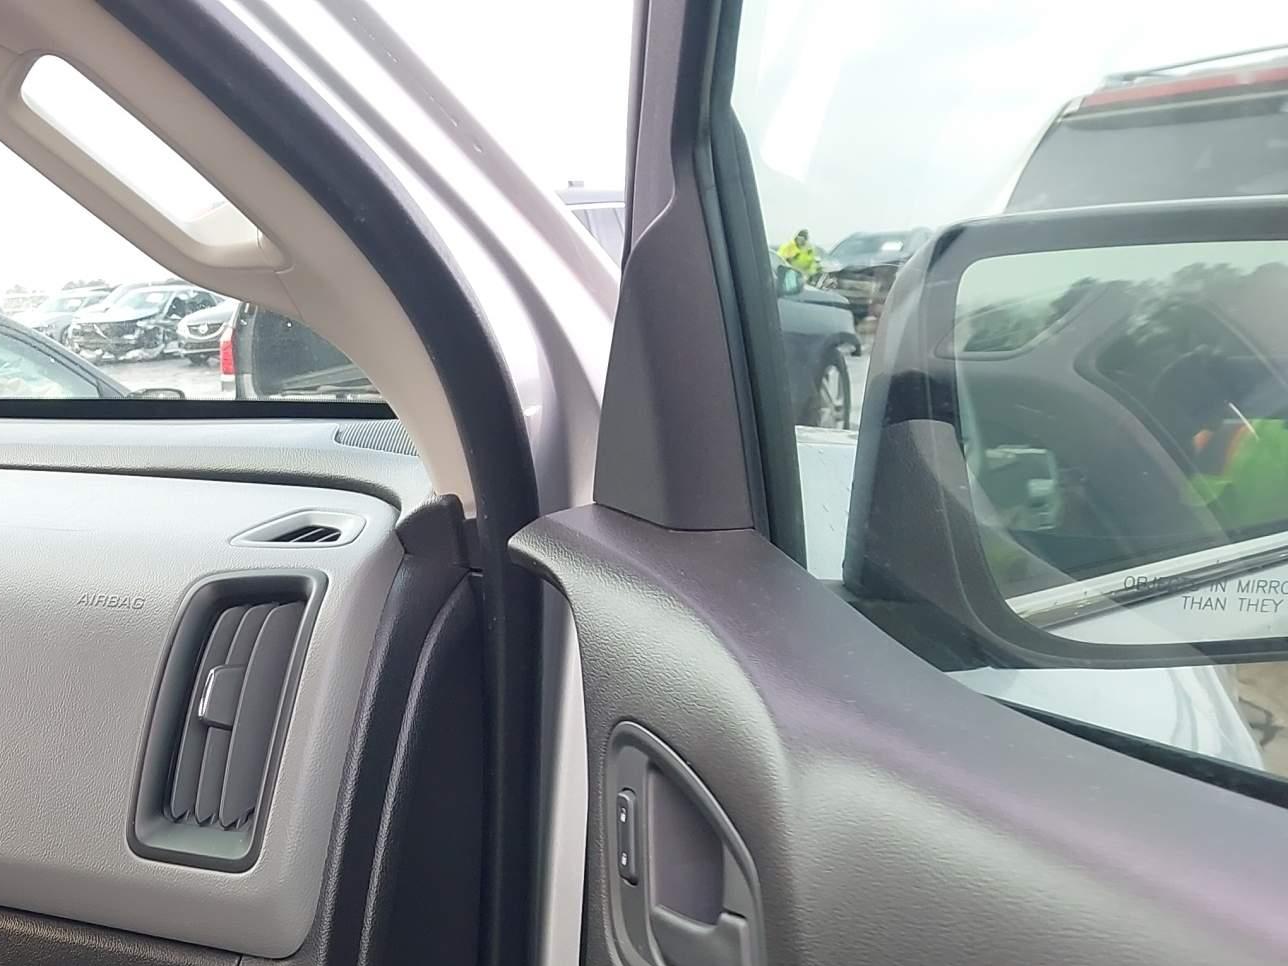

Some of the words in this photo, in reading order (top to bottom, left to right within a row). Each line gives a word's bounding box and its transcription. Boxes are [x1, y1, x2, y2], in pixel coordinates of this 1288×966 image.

[1210, 579, 1227, 593] IN
[1236, 579, 1288, 595] MIRRO
[77, 592, 146, 610] AIRBAG
[1182, 596, 1227, 610] THAN
[1238, 597, 1284, 613] THEY
